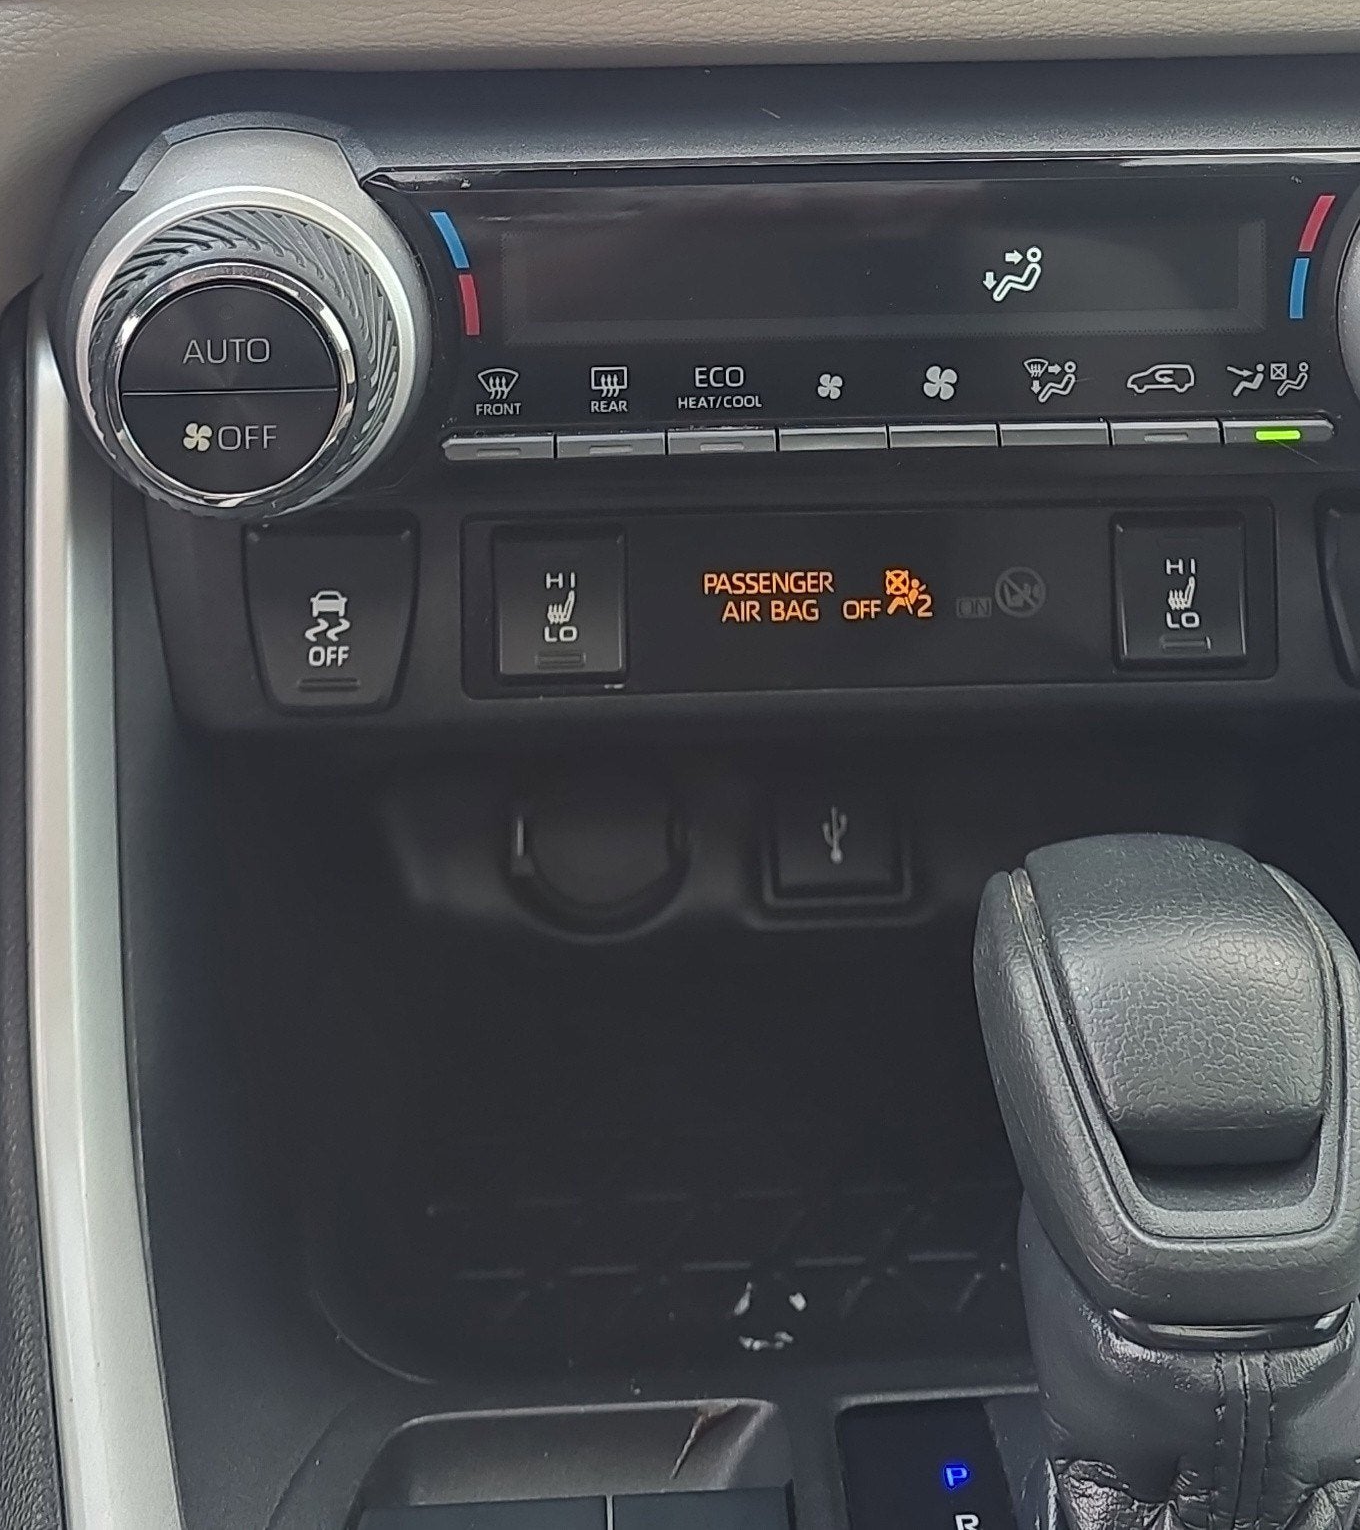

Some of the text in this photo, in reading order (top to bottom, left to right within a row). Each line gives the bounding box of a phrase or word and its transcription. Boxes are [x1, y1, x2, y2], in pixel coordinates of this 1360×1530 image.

[182, 338, 270, 364] AUTO
[694, 366, 744, 388] ECO
[475, 402, 522, 416] FRONT
[590, 400, 628, 413] REAR
[677, 395, 763, 409] HEAT/COOL
[218, 424, 277, 451] OFF
[1166, 558, 1196, 575] HI
[545, 572, 576, 589] HI
[704, 571, 835, 595] PASSENGER
[721, 600, 762, 623] AIR
[770, 599, 819, 622] BAG
[842, 599, 882, 620] OFF
[1166, 611, 1200, 629] LO
[544, 625, 578, 643] LO
[308, 645, 350, 667] OFF
[945, 1467, 968, 1487] P
[955, 1514, 979, 1530] R
